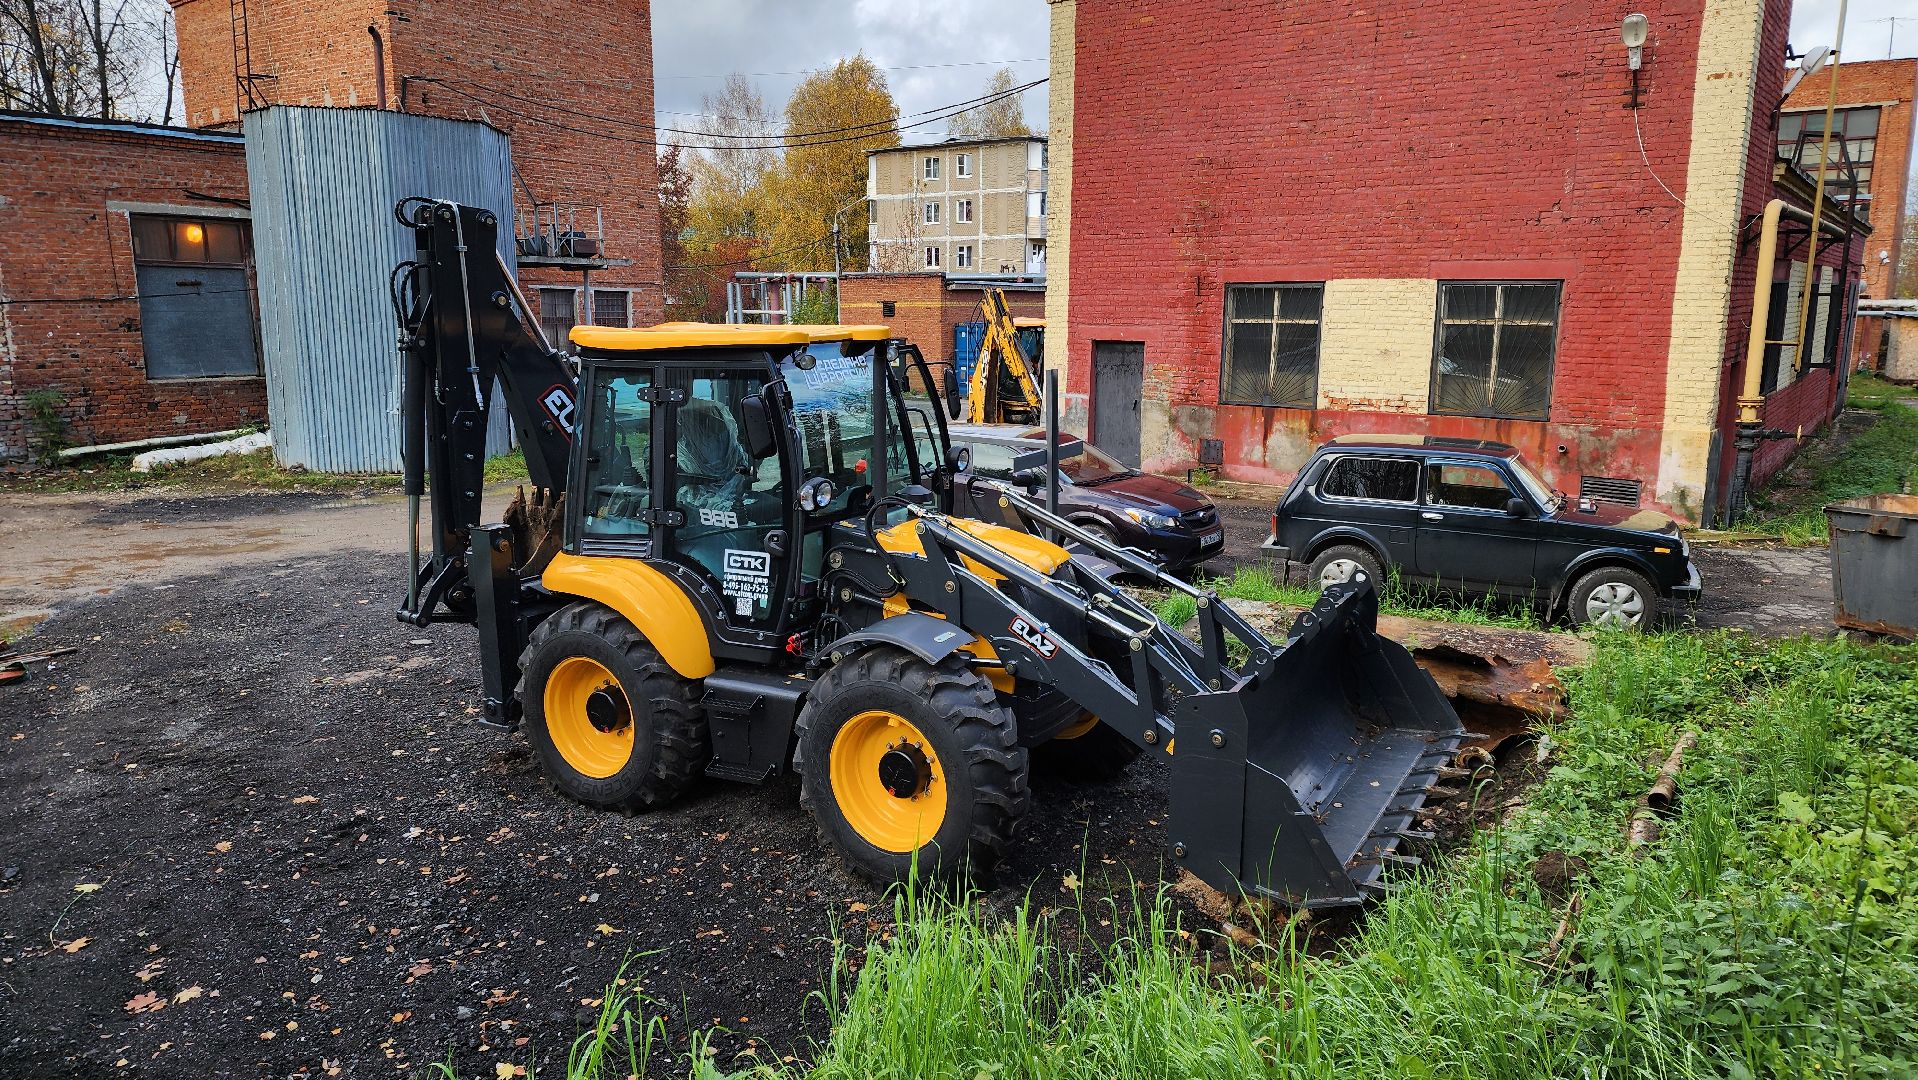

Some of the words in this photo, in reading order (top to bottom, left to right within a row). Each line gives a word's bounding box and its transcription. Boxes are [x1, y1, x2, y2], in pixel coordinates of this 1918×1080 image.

[816, 356, 866, 371] СДЕЛАНО
[544, 389, 574, 434] EL
[729, 555, 763, 570] СТК
[1012, 618, 1056, 657] ELAZ
